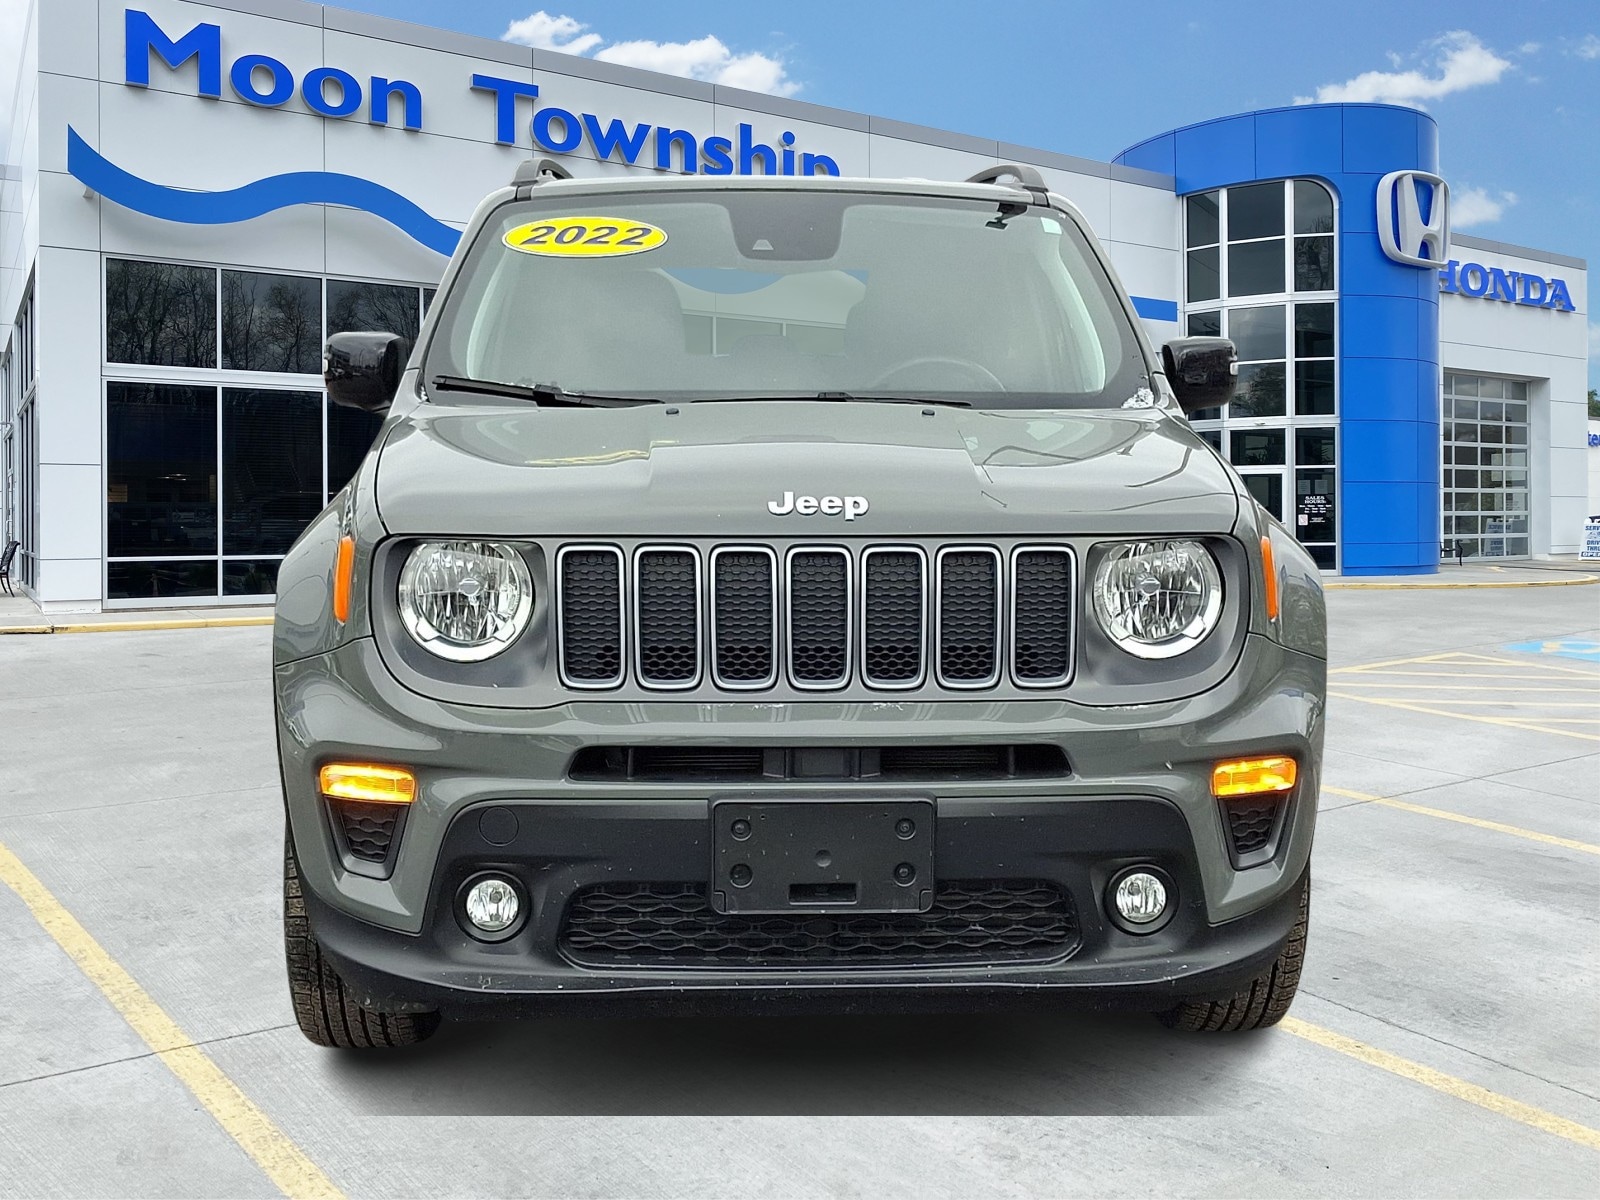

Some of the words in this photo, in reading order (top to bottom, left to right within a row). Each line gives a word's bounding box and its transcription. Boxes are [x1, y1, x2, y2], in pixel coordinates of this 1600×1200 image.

[124, 8, 422, 131] Moon
[519, 225, 652, 246] 2022
[767, 491, 869, 521] Jeep
